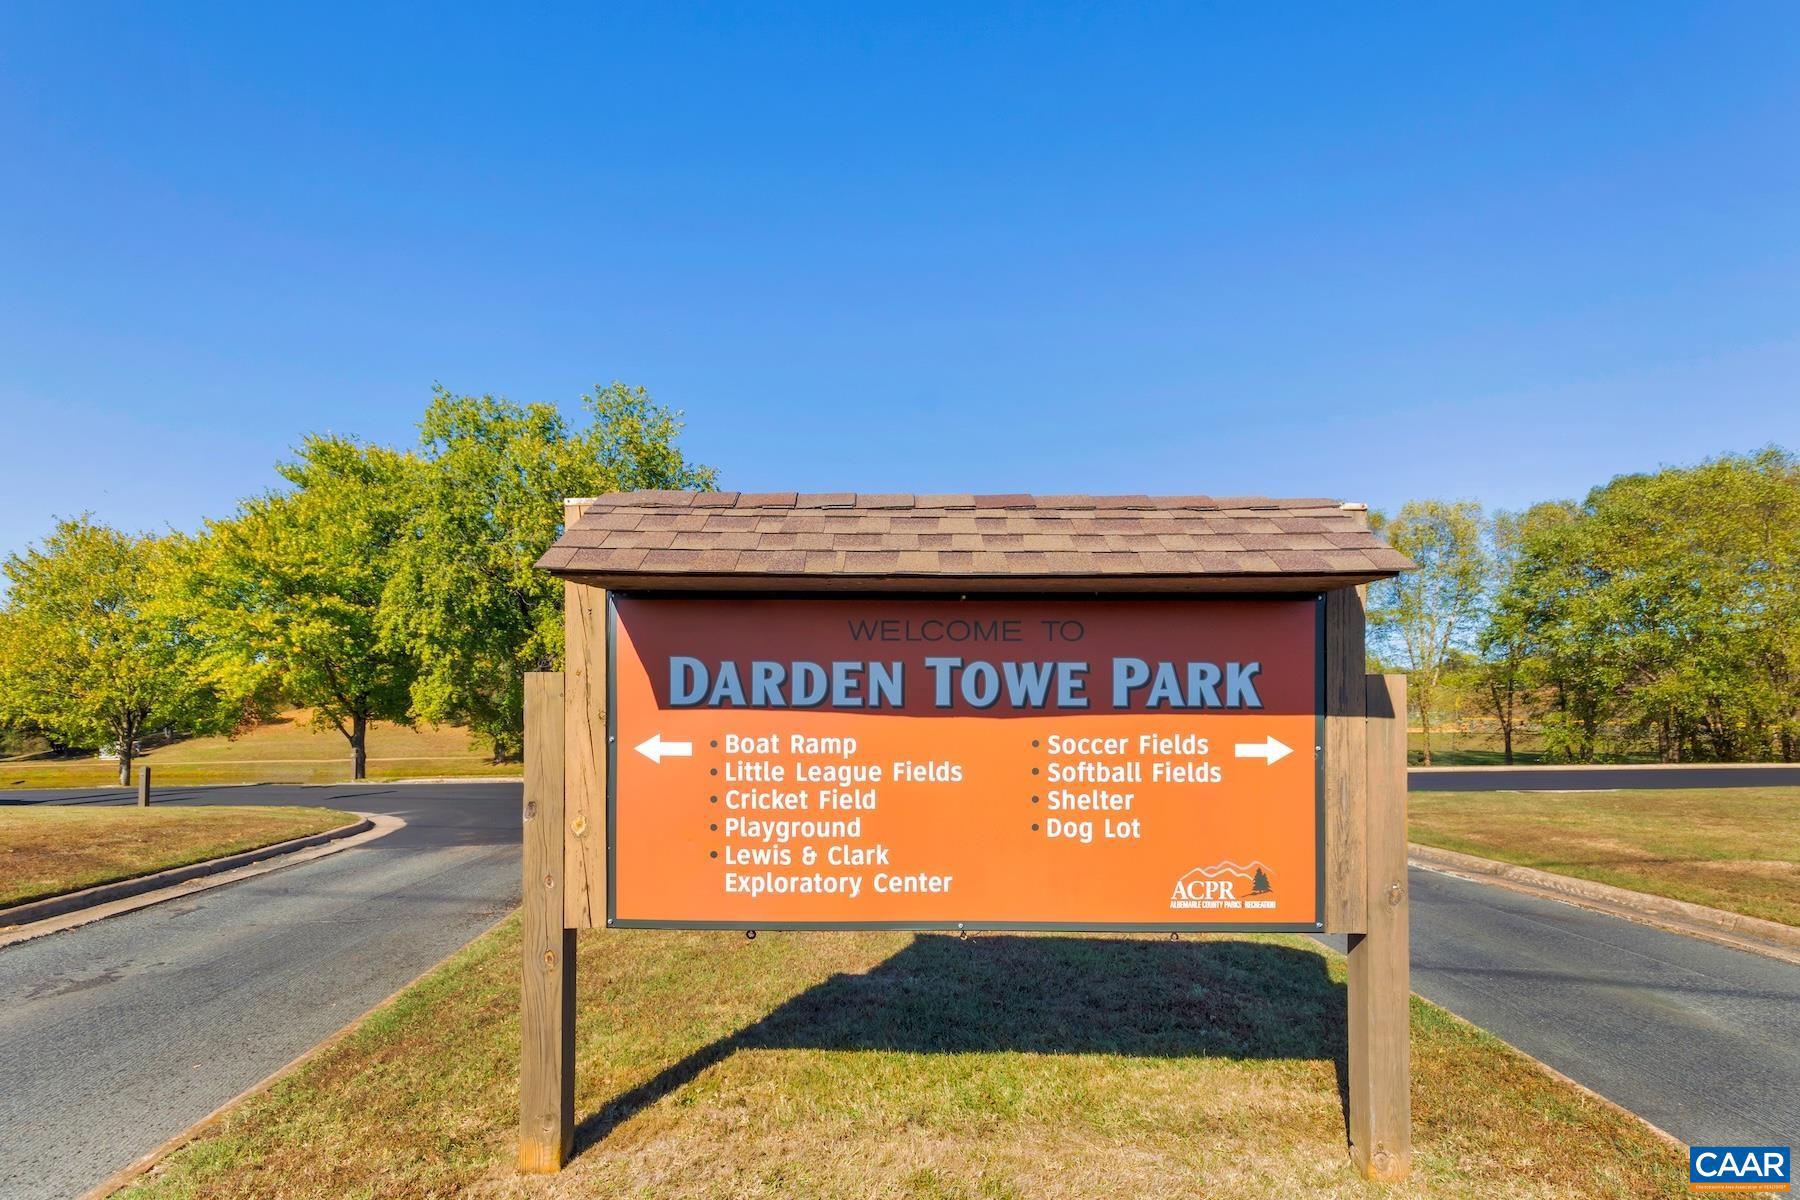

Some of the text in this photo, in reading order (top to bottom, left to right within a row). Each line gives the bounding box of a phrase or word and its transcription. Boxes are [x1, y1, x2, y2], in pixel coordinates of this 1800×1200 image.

[848, 619, 1084, 642] WELCOME TO
[669, 656, 1263, 709] DARDEN TOWE PARK
[725, 733, 857, 760] Boat Ramp
[1047, 733, 1209, 755] Soccer Fields
[725, 760, 963, 788] Little League Fields
[1047, 761, 1222, 783] Softball Fields
[725, 787, 877, 810] Cricket Field
[1047, 789, 1135, 811] Shelter
[725, 815, 861, 842] Playground
[1046, 817, 1141, 844] Dog Lot
[725, 844, 890, 866] Lewis & Clark
[725, 871, 953, 898] Exploratory Center
[1170, 880, 1236, 900] ACPR
[1202, 900, 1223, 909] COUNTY
